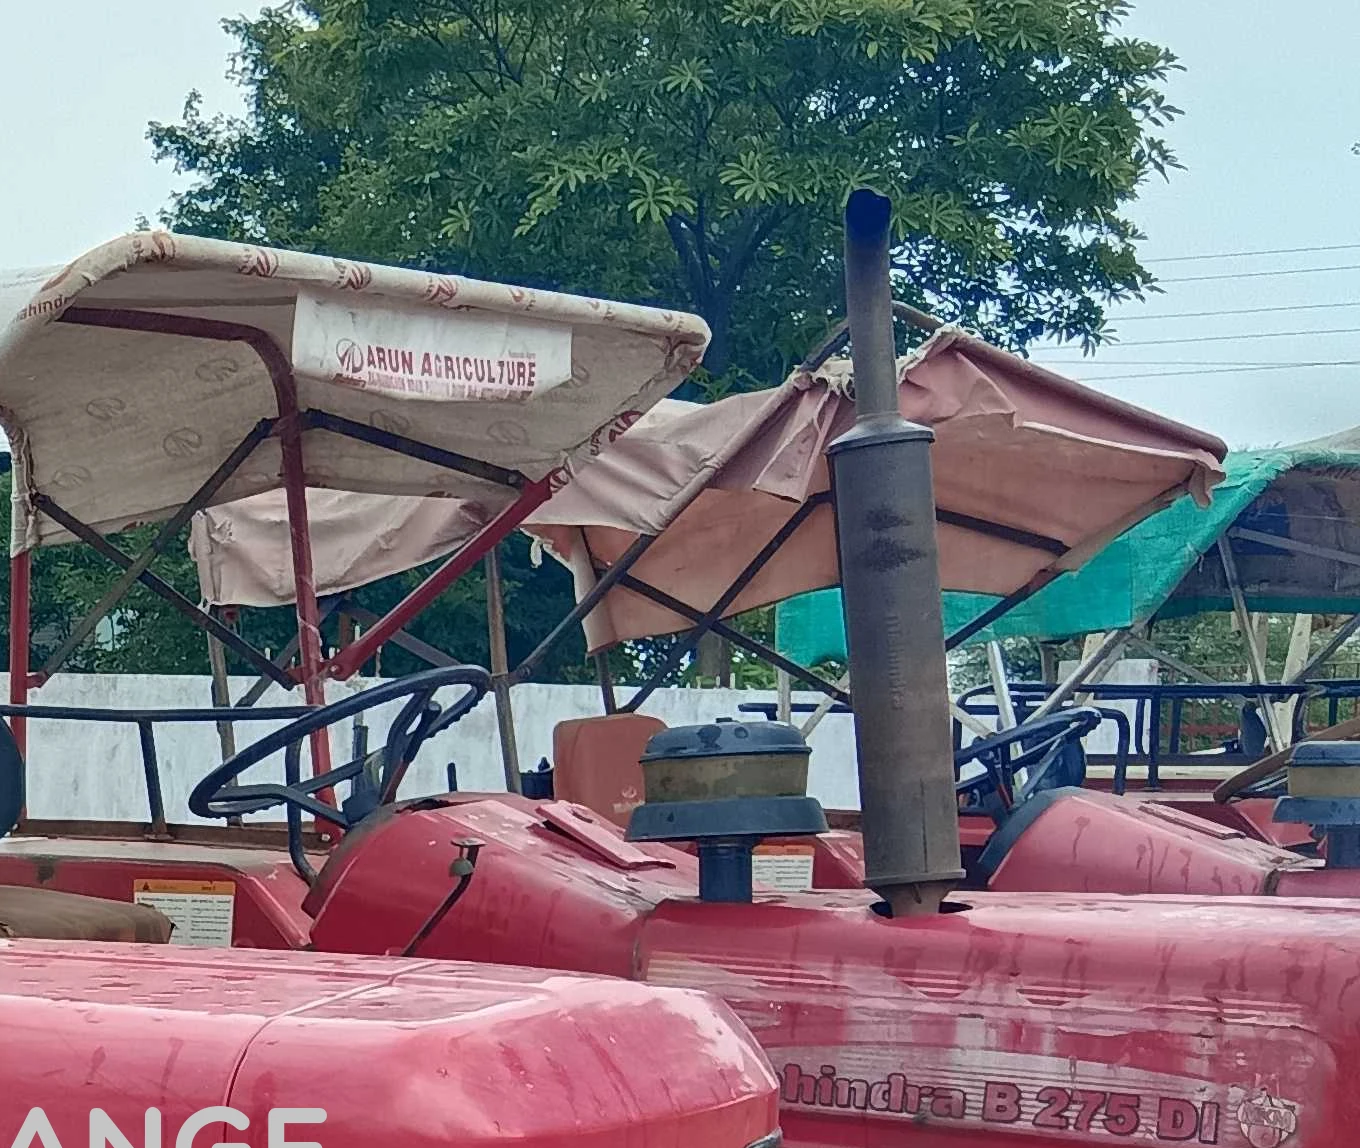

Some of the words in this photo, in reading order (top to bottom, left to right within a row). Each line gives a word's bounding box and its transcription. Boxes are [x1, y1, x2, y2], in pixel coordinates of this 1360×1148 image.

[367, 345, 414, 375] ARUN
[421, 351, 536, 387] AGRICULTURE
[982, 1082, 1022, 1124] B
[1038, 1087, 1144, 1137] 275
[1157, 1098, 1220, 1146] DI
